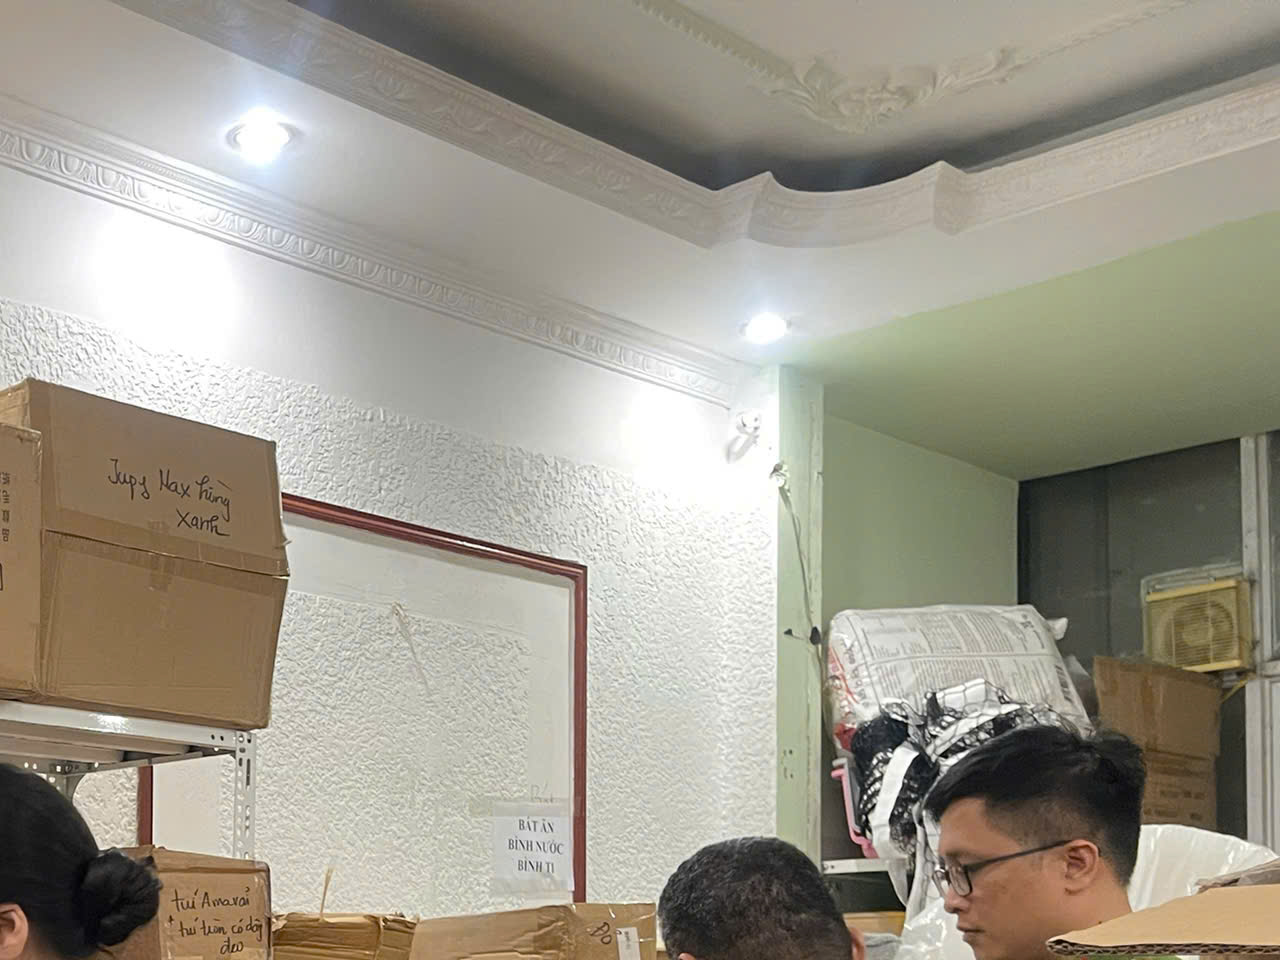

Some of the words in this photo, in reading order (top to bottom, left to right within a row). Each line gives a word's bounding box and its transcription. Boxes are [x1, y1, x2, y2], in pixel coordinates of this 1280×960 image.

[108, 458, 150, 500] Jupy
[508, 836, 534, 852] BÌNH
[535, 840, 565, 855] NƯỚC
[517, 857, 543, 873] BÌNH
